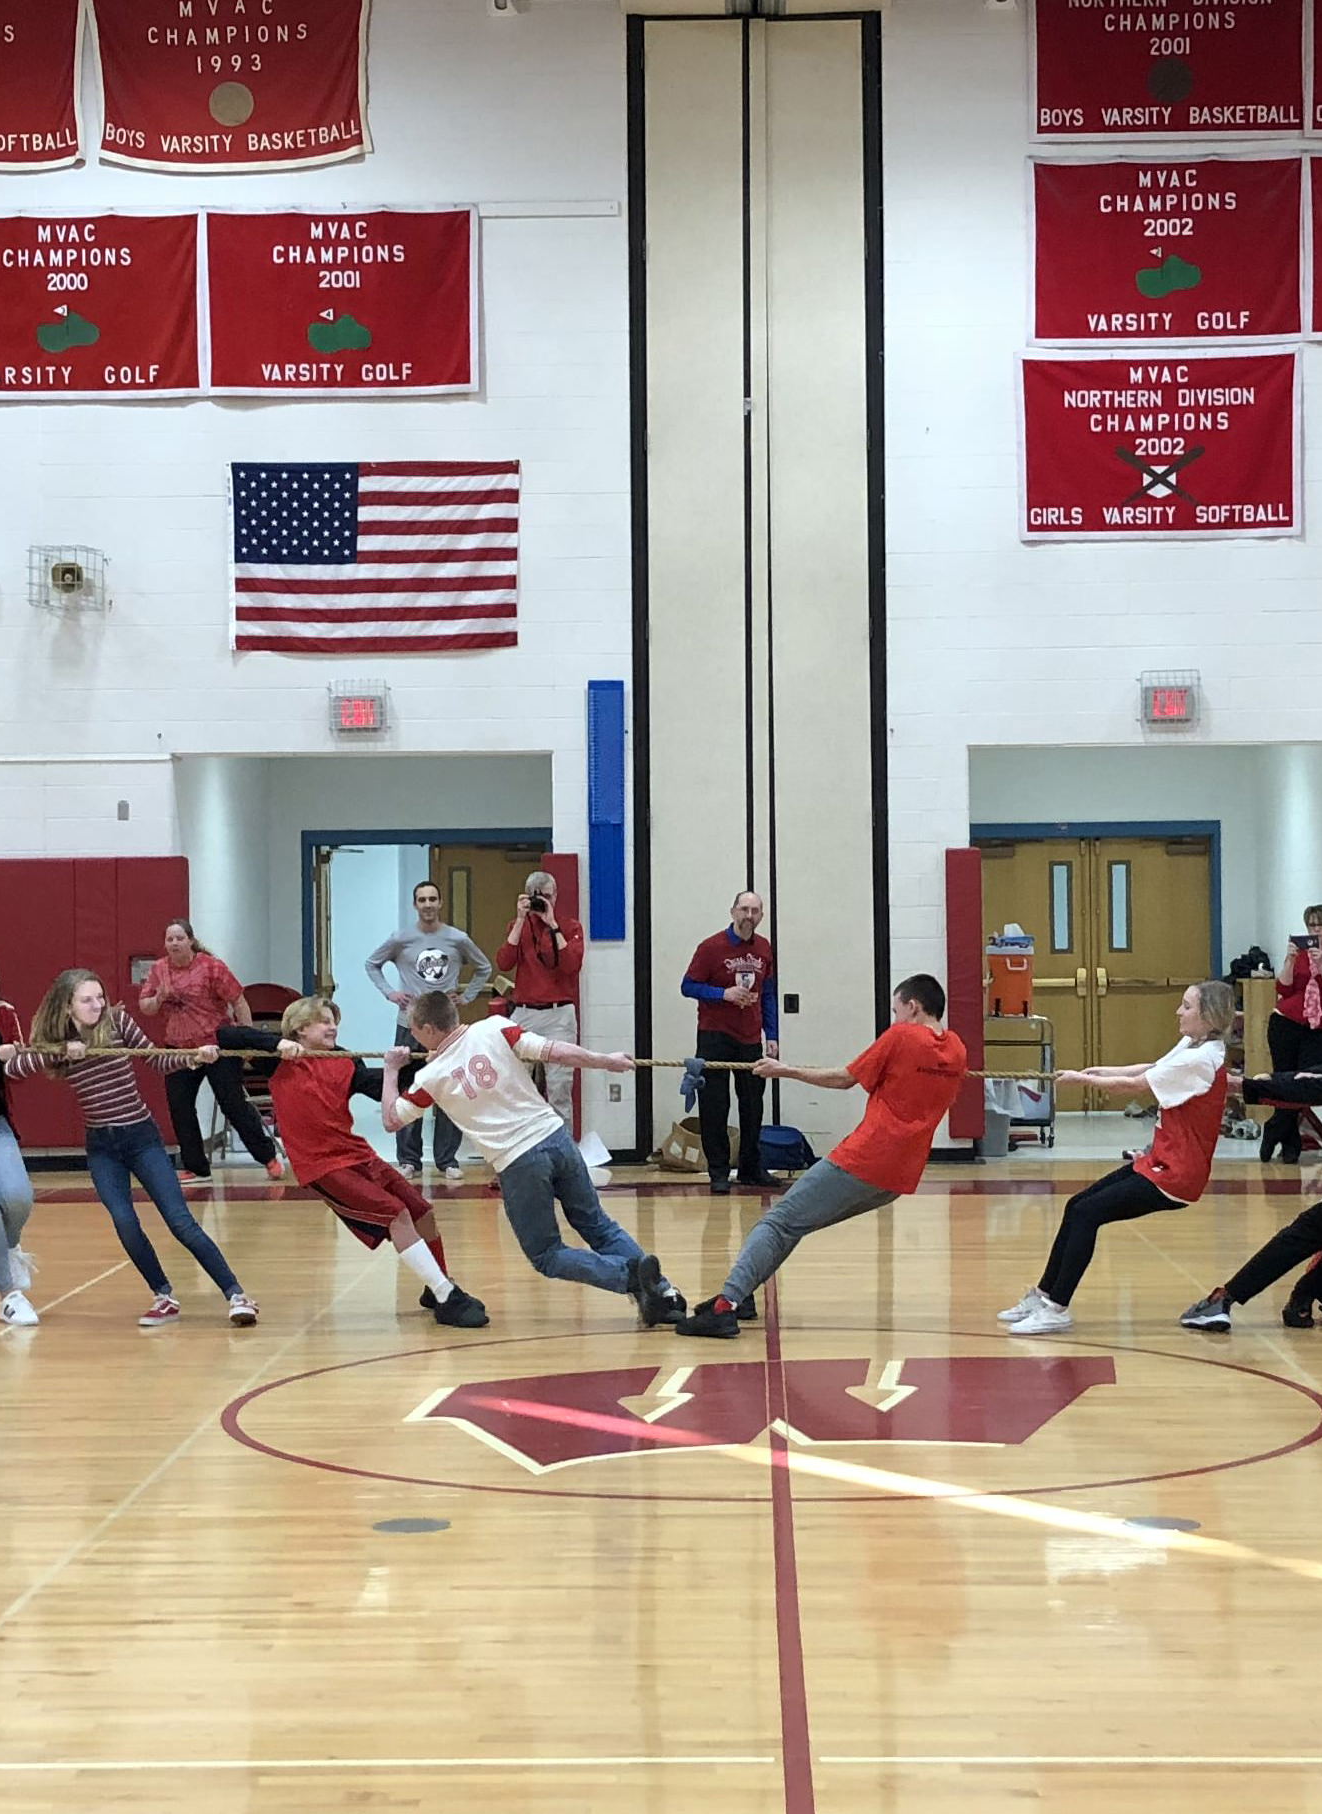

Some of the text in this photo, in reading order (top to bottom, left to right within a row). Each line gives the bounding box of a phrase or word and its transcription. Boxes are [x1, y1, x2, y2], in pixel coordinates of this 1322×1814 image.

[1104, 11, 1236, 32] CHAMPIONS
[147, 23, 307, 46] CHAMPIONS
[1149, 36, 1190, 56] 2001
[197, 53, 262, 74] 1993
[1040, 104, 1300, 127] BOYS VARSITY BASKETBALL
[105, 119, 360, 154] BOYS VARSITY BASKETBALL
[1138, 169, 1197, 188] MVAC
[1099, 191, 1237, 213] CHAMPIONS
[37, 223, 96, 244] MVAC
[310, 220, 367, 240] MVAC
[1143, 217, 1194, 237] 2002
[2, 247, 132, 268] CHAMPIONS
[272, 244, 405, 264] CHAMPIONS
[46, 272, 89, 292] 2000
[318, 270, 361, 289] 2001
[1087, 310, 1250, 332] VARSITY GOLF
[104, 364, 160, 384] GOLF
[261, 362, 412, 382] VARSITY GOLF
[1129, 365, 1189, 384] MVAC
[1063, 386, 1255, 408] NORTHERN DIVISION
[1090, 411, 1229, 433] CHAMPIONS
[1134, 437, 1185, 456] 2002
[1030, 503, 1289, 526] GIRLS VARSITY SOFTBALL
[451, 1054, 498, 1100] 18
